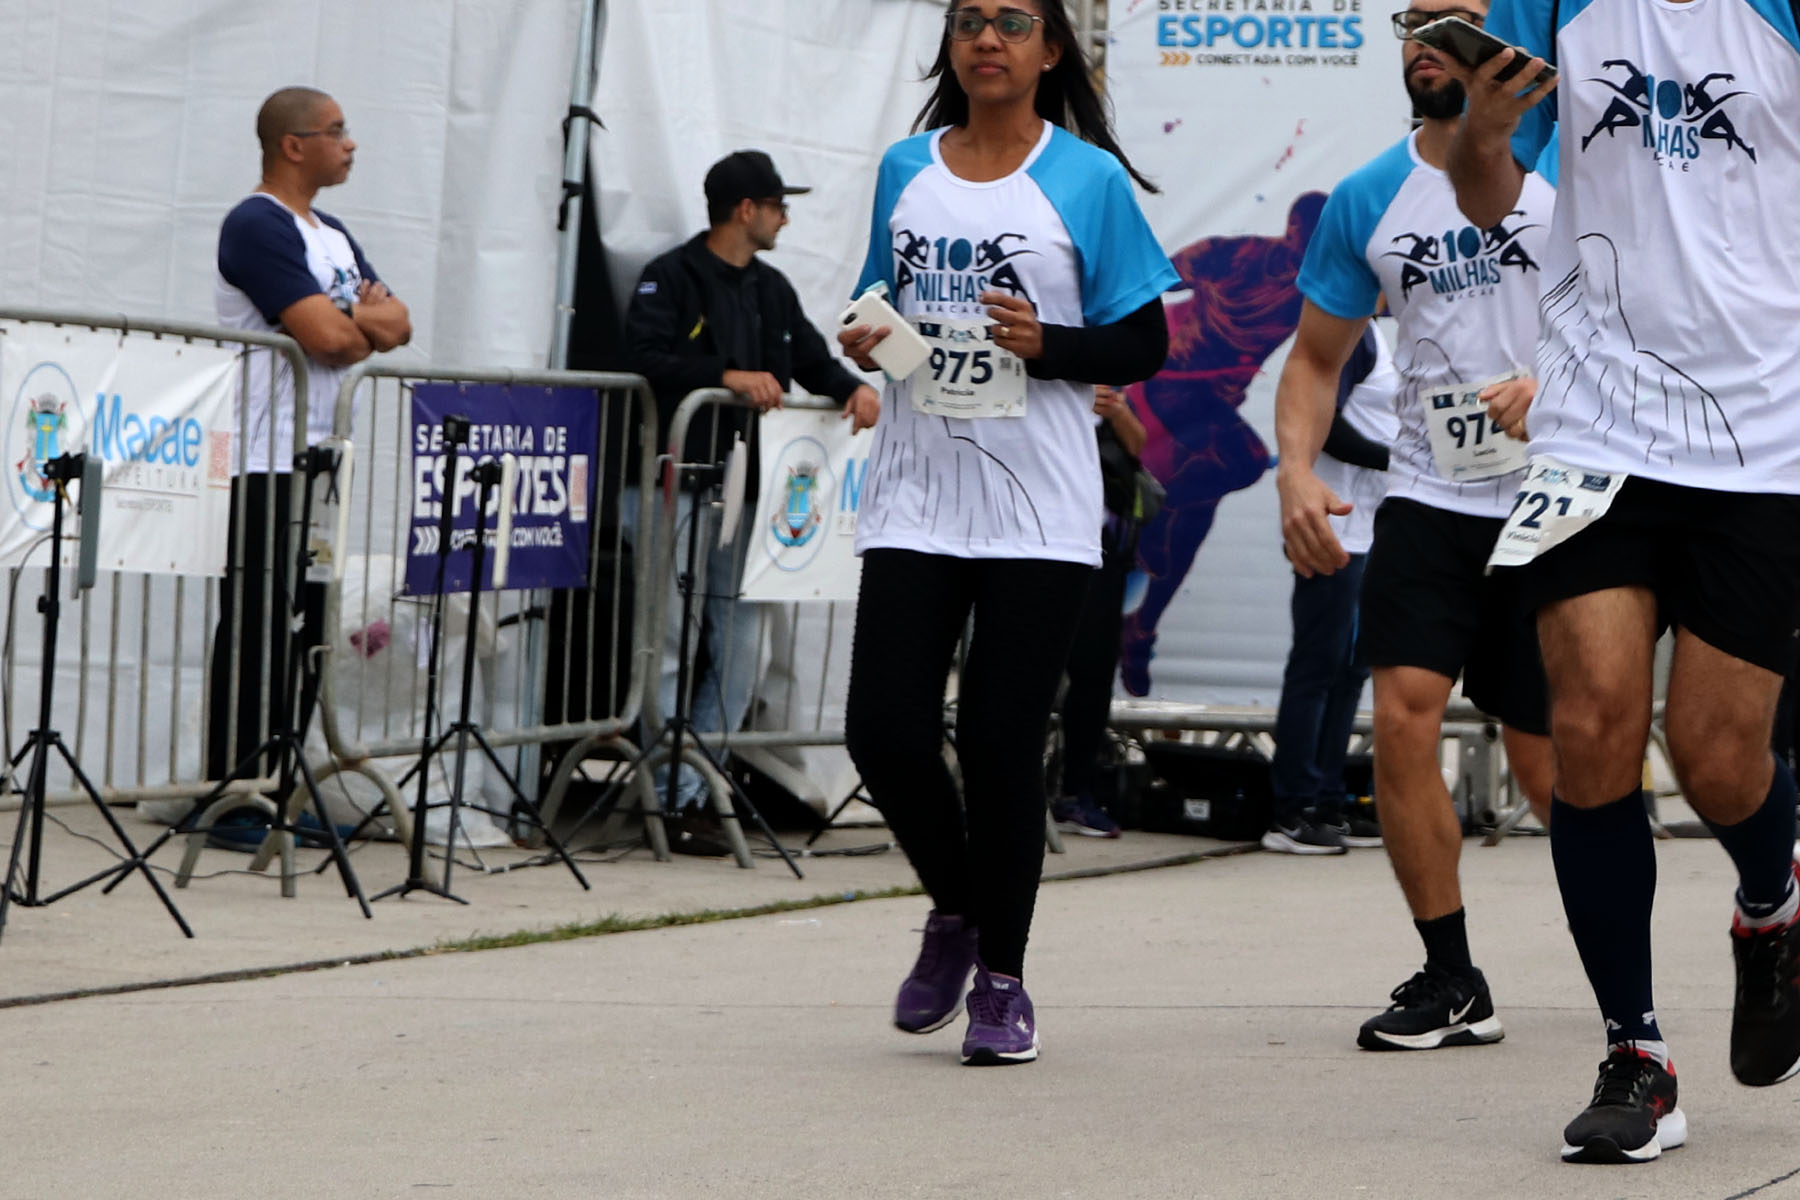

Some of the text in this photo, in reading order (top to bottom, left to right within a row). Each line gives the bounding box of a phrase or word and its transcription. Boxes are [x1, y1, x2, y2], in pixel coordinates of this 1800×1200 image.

[1157, 14, 1364, 50] ESPORTES
[1197, 50, 1359, 67] CONECTADA COM VOCÊ
[934, 237, 972, 271] 10
[1442, 226, 1481, 263] 10
[1429, 258, 1501, 295] MILHAS
[929, 347, 993, 384] 975
[543, 426, 567, 453] DE
